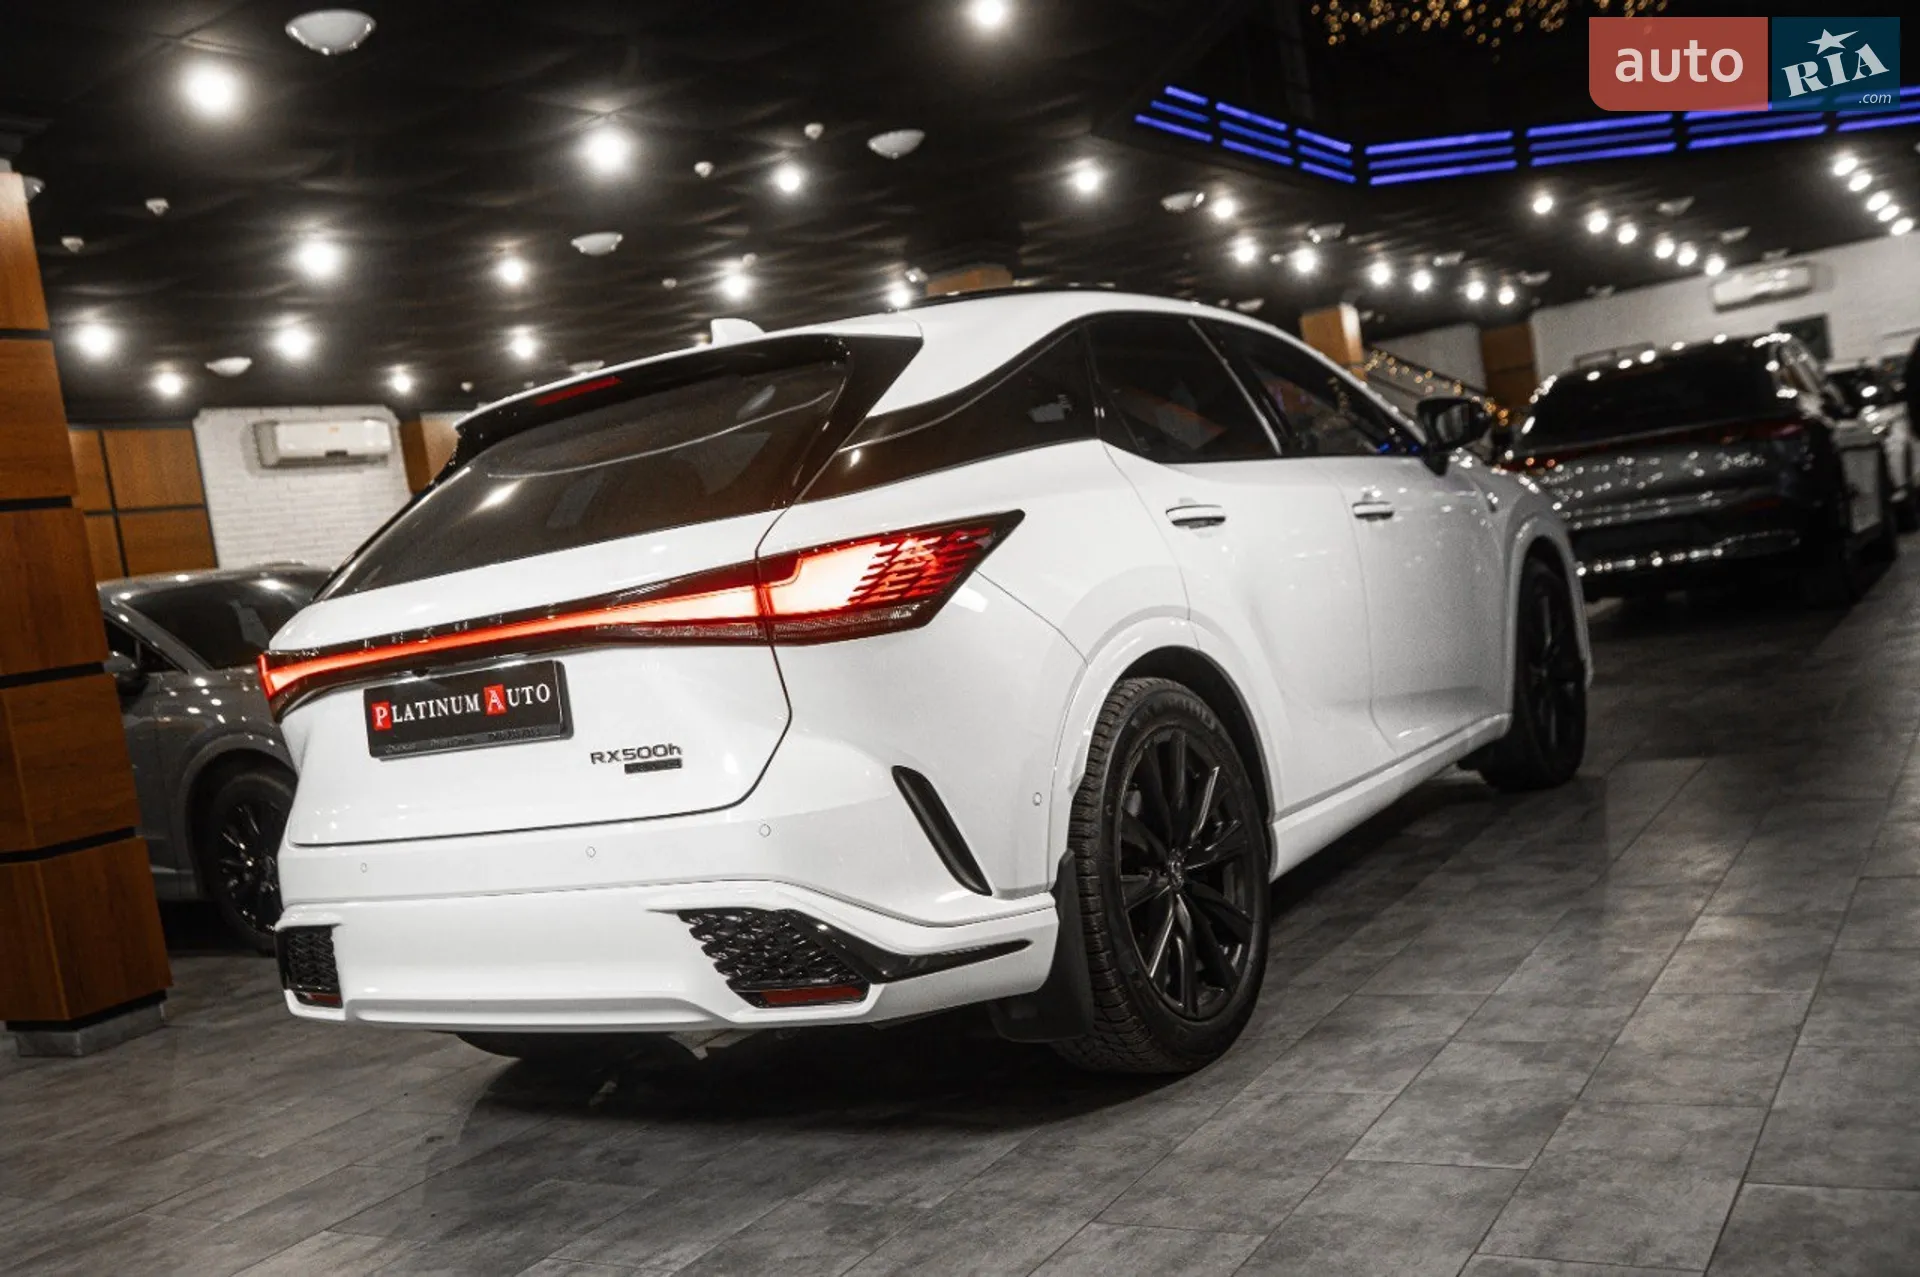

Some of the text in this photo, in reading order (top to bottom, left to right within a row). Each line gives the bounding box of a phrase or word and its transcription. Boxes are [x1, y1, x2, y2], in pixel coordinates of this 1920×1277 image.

[374, 683, 551, 728] PLATINUM AUTO
[590, 743, 682, 765] RX500h
